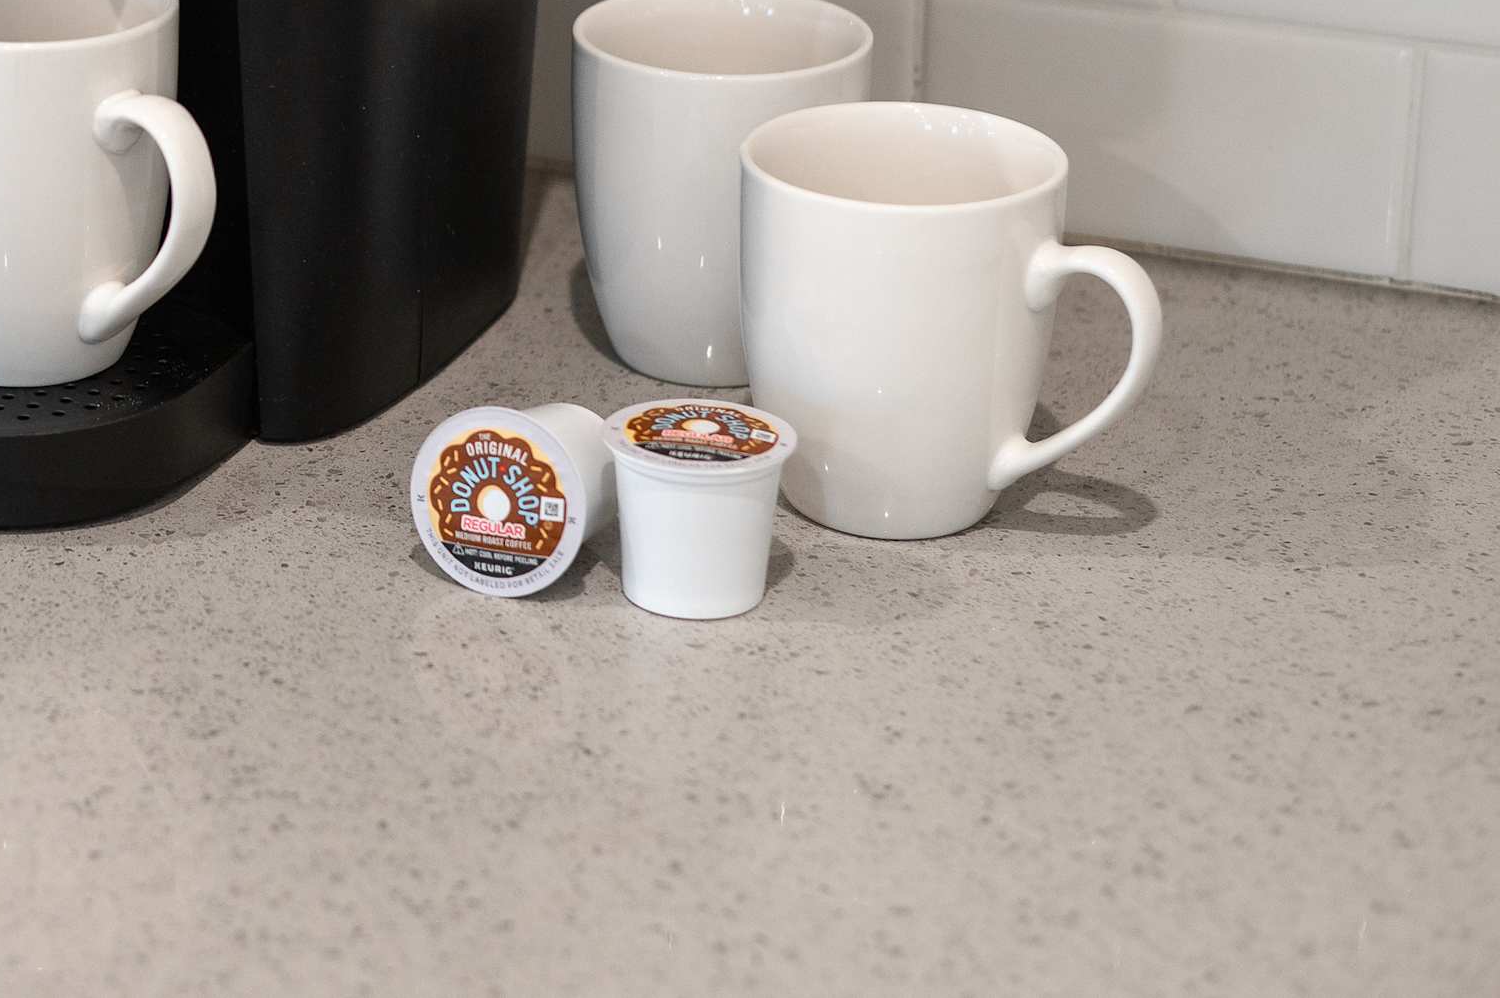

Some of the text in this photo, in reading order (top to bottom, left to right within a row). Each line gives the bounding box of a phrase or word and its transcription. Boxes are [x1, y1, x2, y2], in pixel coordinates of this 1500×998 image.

[651, 410, 750, 440] DONUT SHOP
[465, 441, 528, 466] ORIGINAL
[450, 456, 540, 526] DONUT SHOP
[462, 515, 525, 538] REGULAR
[454, 530, 532, 551] MEDIUM ROAST COFFEE
[473, 561, 513, 576] KEURIG
